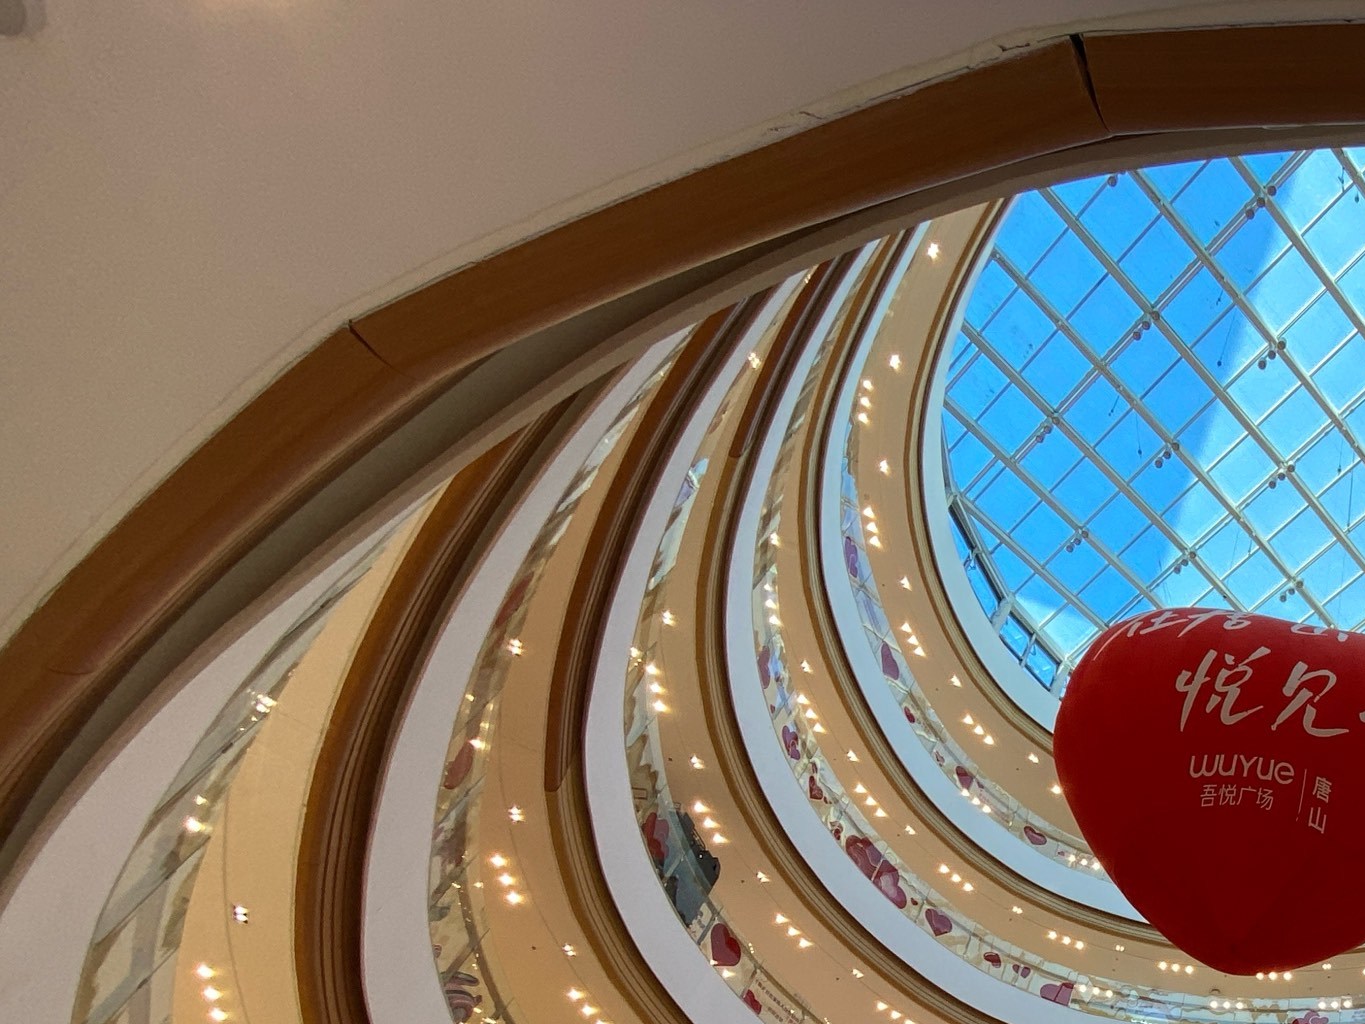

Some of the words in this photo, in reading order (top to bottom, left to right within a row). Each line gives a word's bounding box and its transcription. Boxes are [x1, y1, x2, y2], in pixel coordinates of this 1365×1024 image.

[1199, 783, 1275, 811] 吾悦广场
[1307, 775, 1332, 835] 唐山
